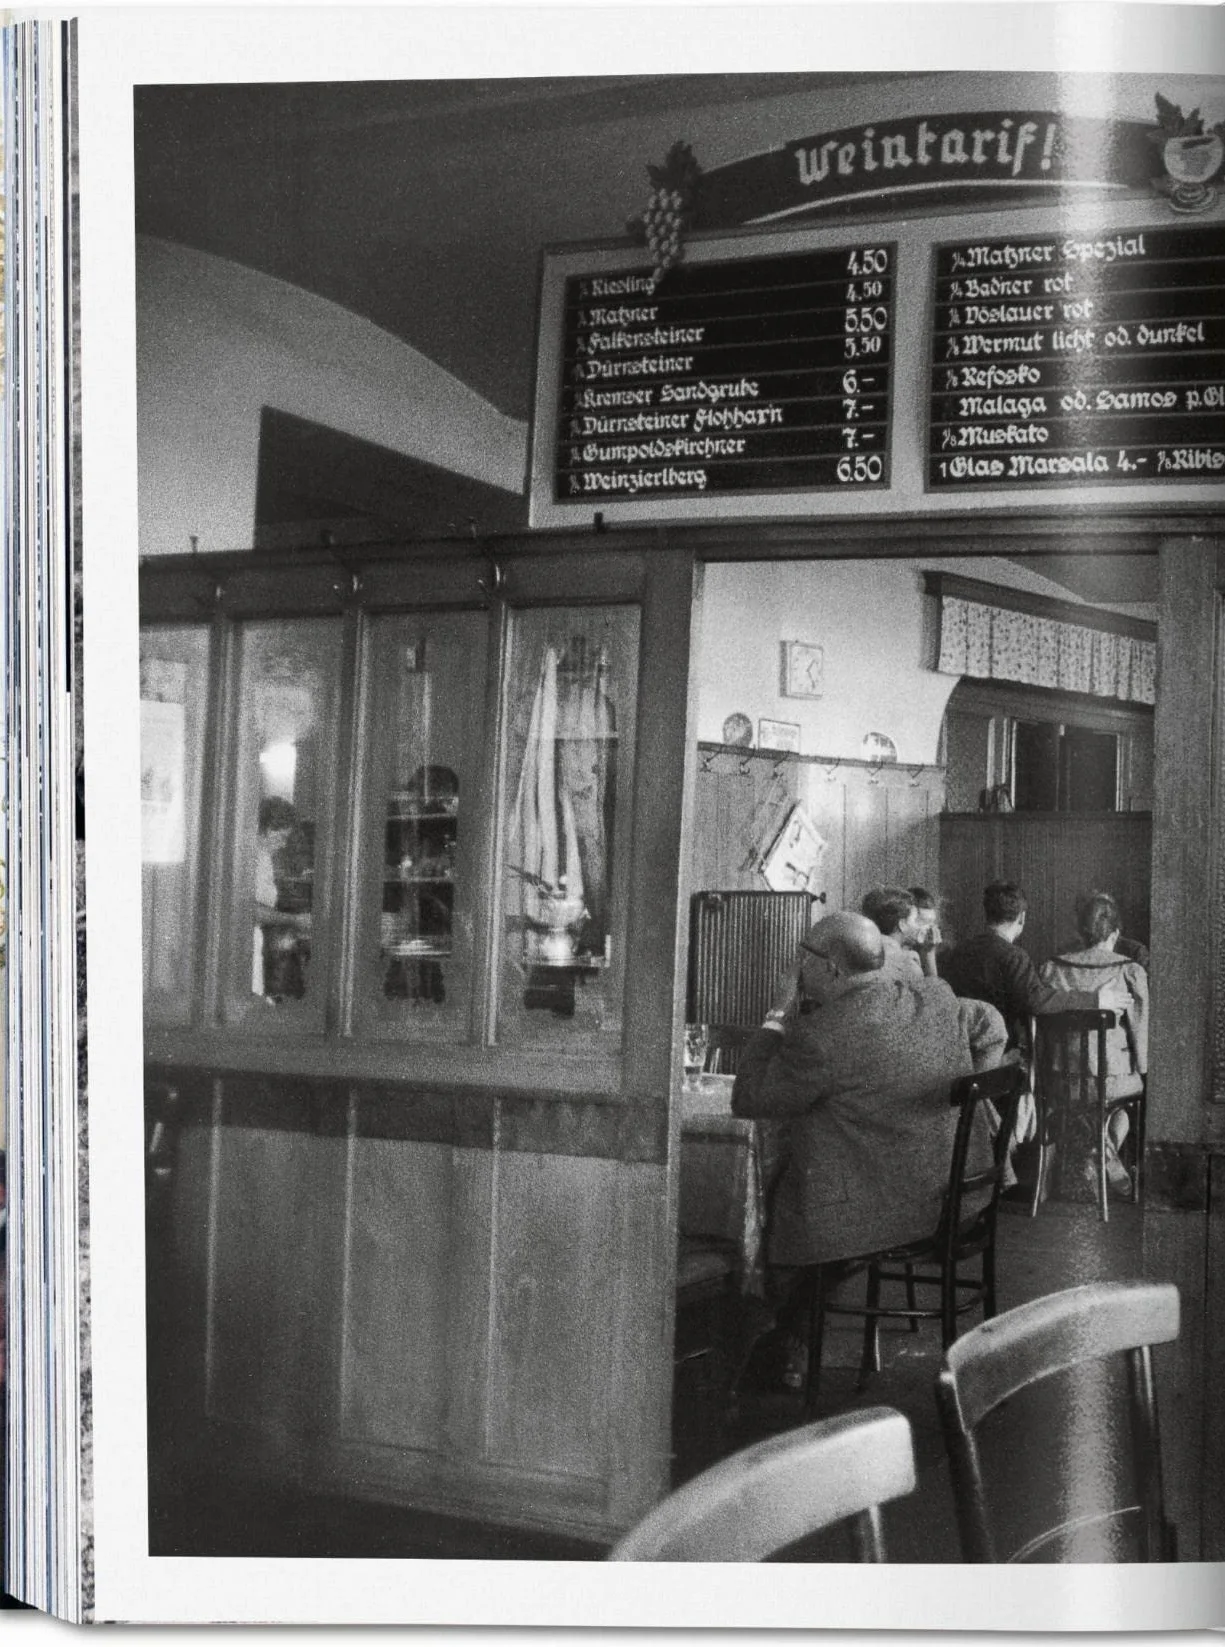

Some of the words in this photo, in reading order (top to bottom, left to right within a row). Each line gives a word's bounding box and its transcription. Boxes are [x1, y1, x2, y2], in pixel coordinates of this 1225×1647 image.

[794, 120, 1055, 185] Weintarif!
[847, 249, 888, 276] 4.50
[846, 280, 883, 302] 4.50
[845, 307, 888, 333] 5.50
[844, 335, 882, 359] 5.50
[959, 395, 1047, 418] Malaga
[837, 455, 883, 482] 6.50
